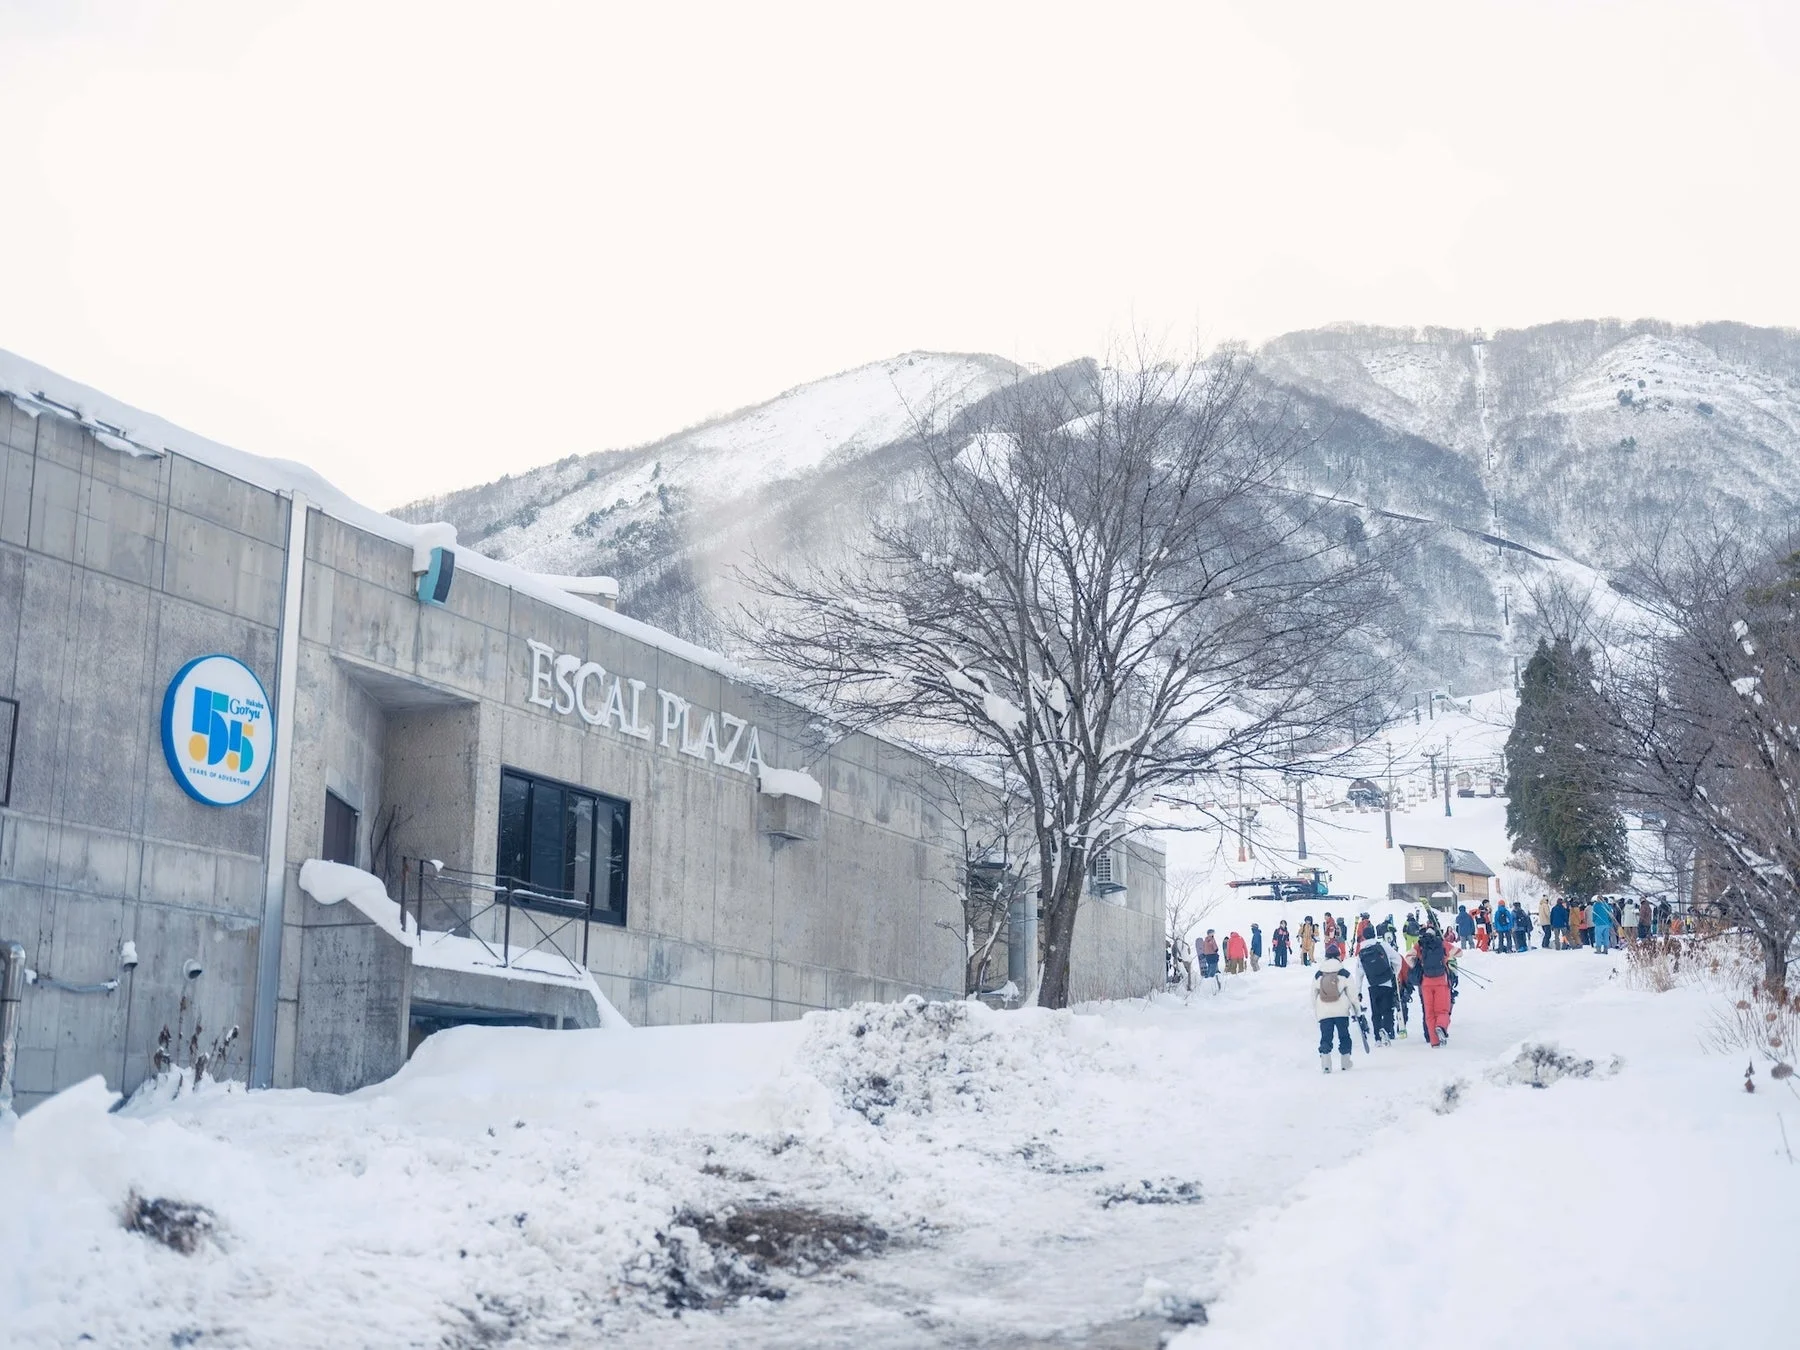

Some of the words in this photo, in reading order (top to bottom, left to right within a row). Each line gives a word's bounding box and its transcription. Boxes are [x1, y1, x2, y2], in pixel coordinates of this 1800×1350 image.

[229, 698, 260, 722] Goryu
[527, 638, 650, 741] ESCAL
[657, 688, 764, 777] PLAZA
[189, 767, 207, 777] YEARS
[218, 774, 250, 786] ADVENTURE
